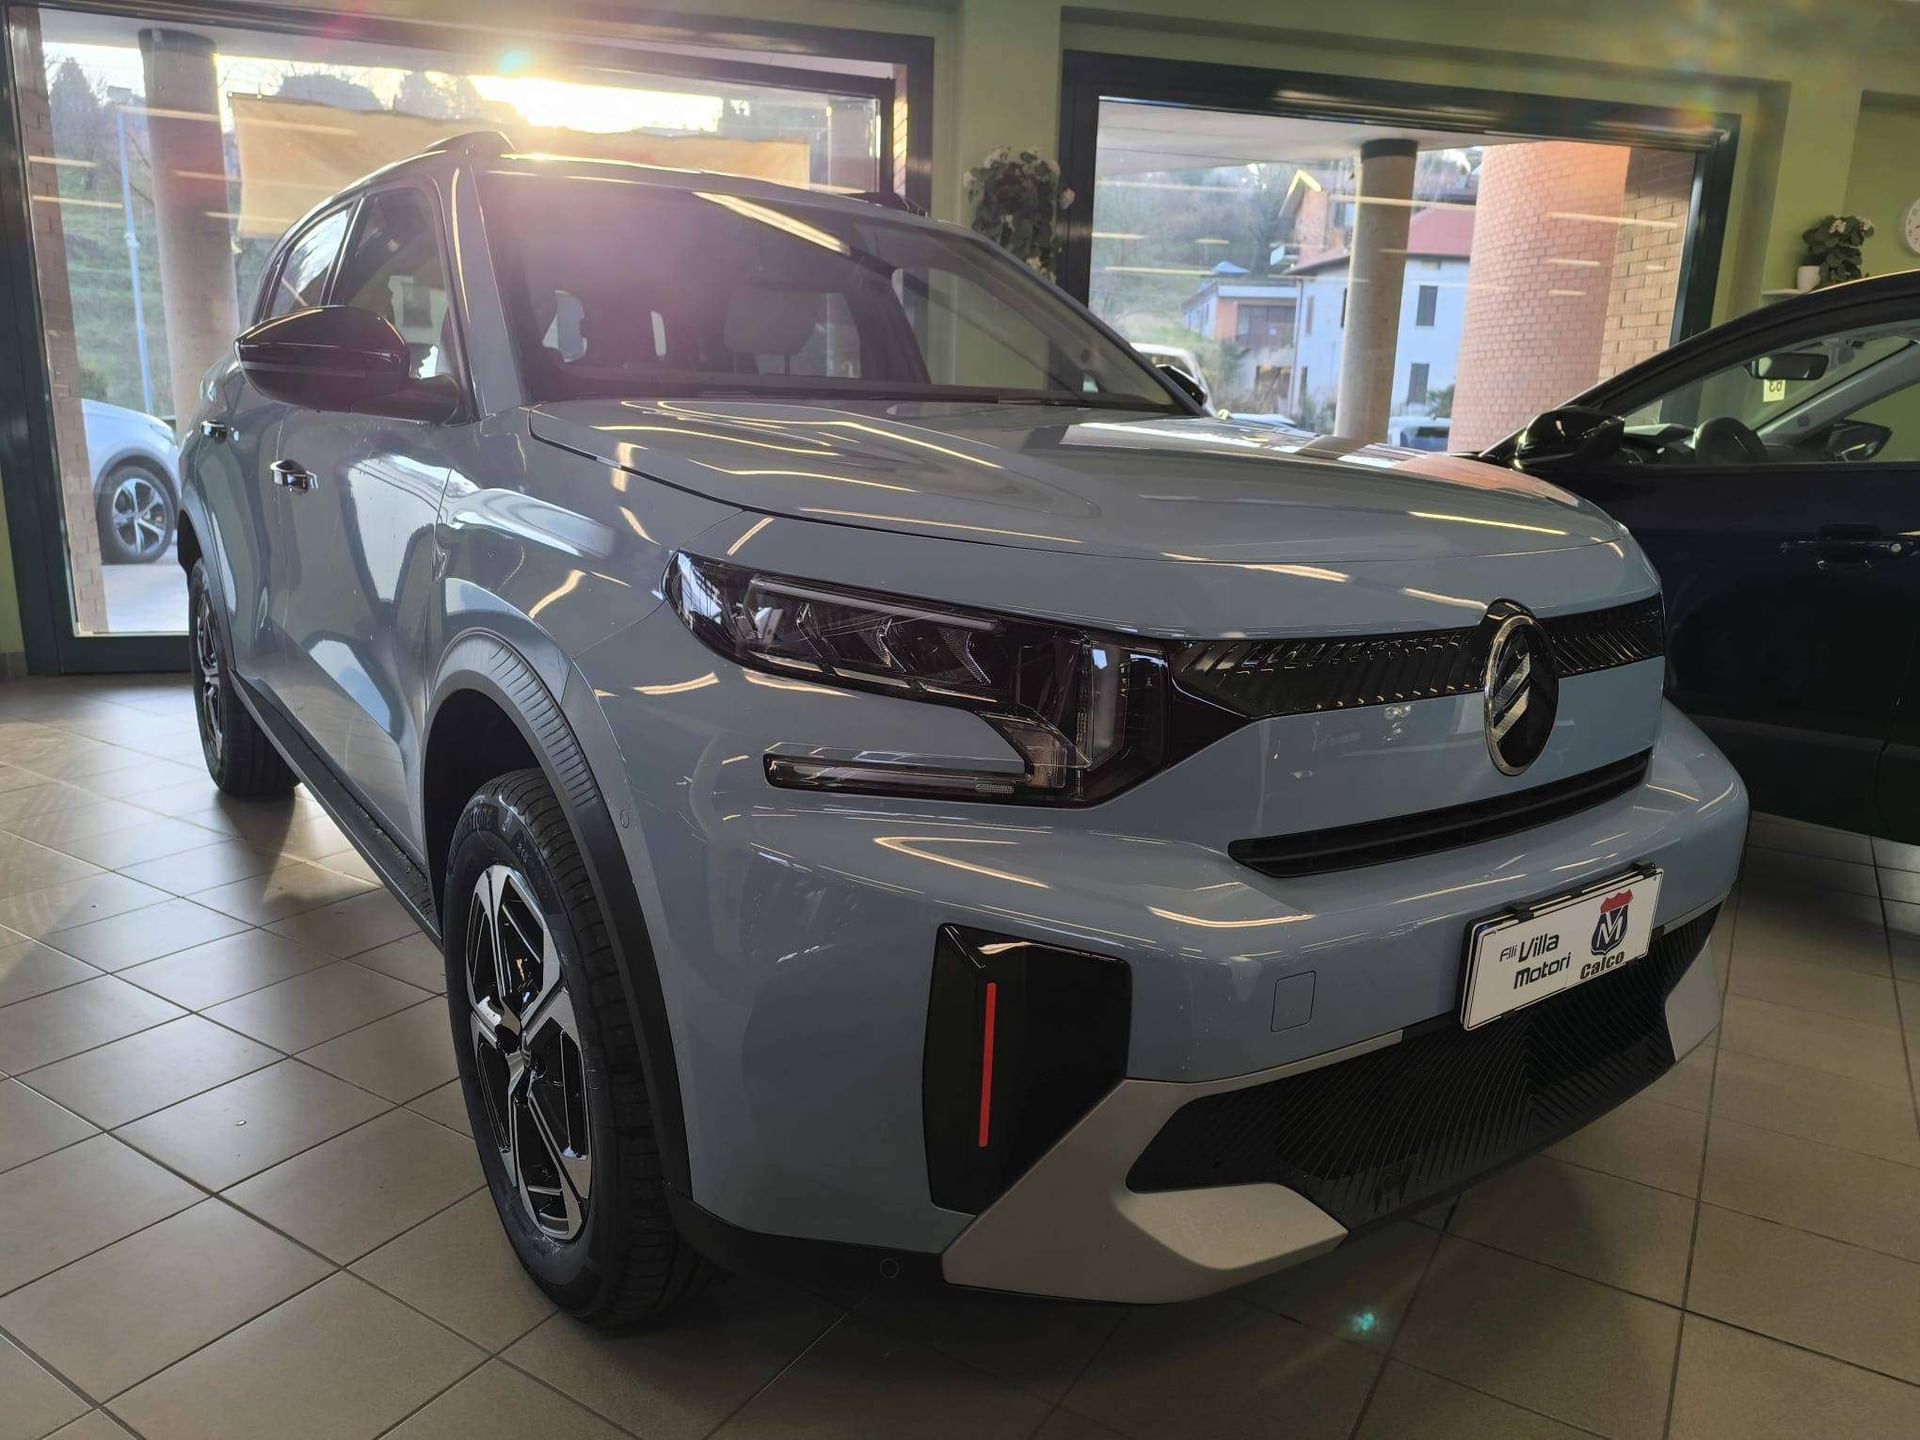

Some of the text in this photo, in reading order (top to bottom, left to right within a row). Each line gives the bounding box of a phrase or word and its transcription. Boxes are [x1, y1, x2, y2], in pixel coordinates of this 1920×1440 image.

[1518, 933, 1560, 963] Villa
[1513, 951, 1572, 990] Motori
[1580, 951, 1625, 980] Calco
